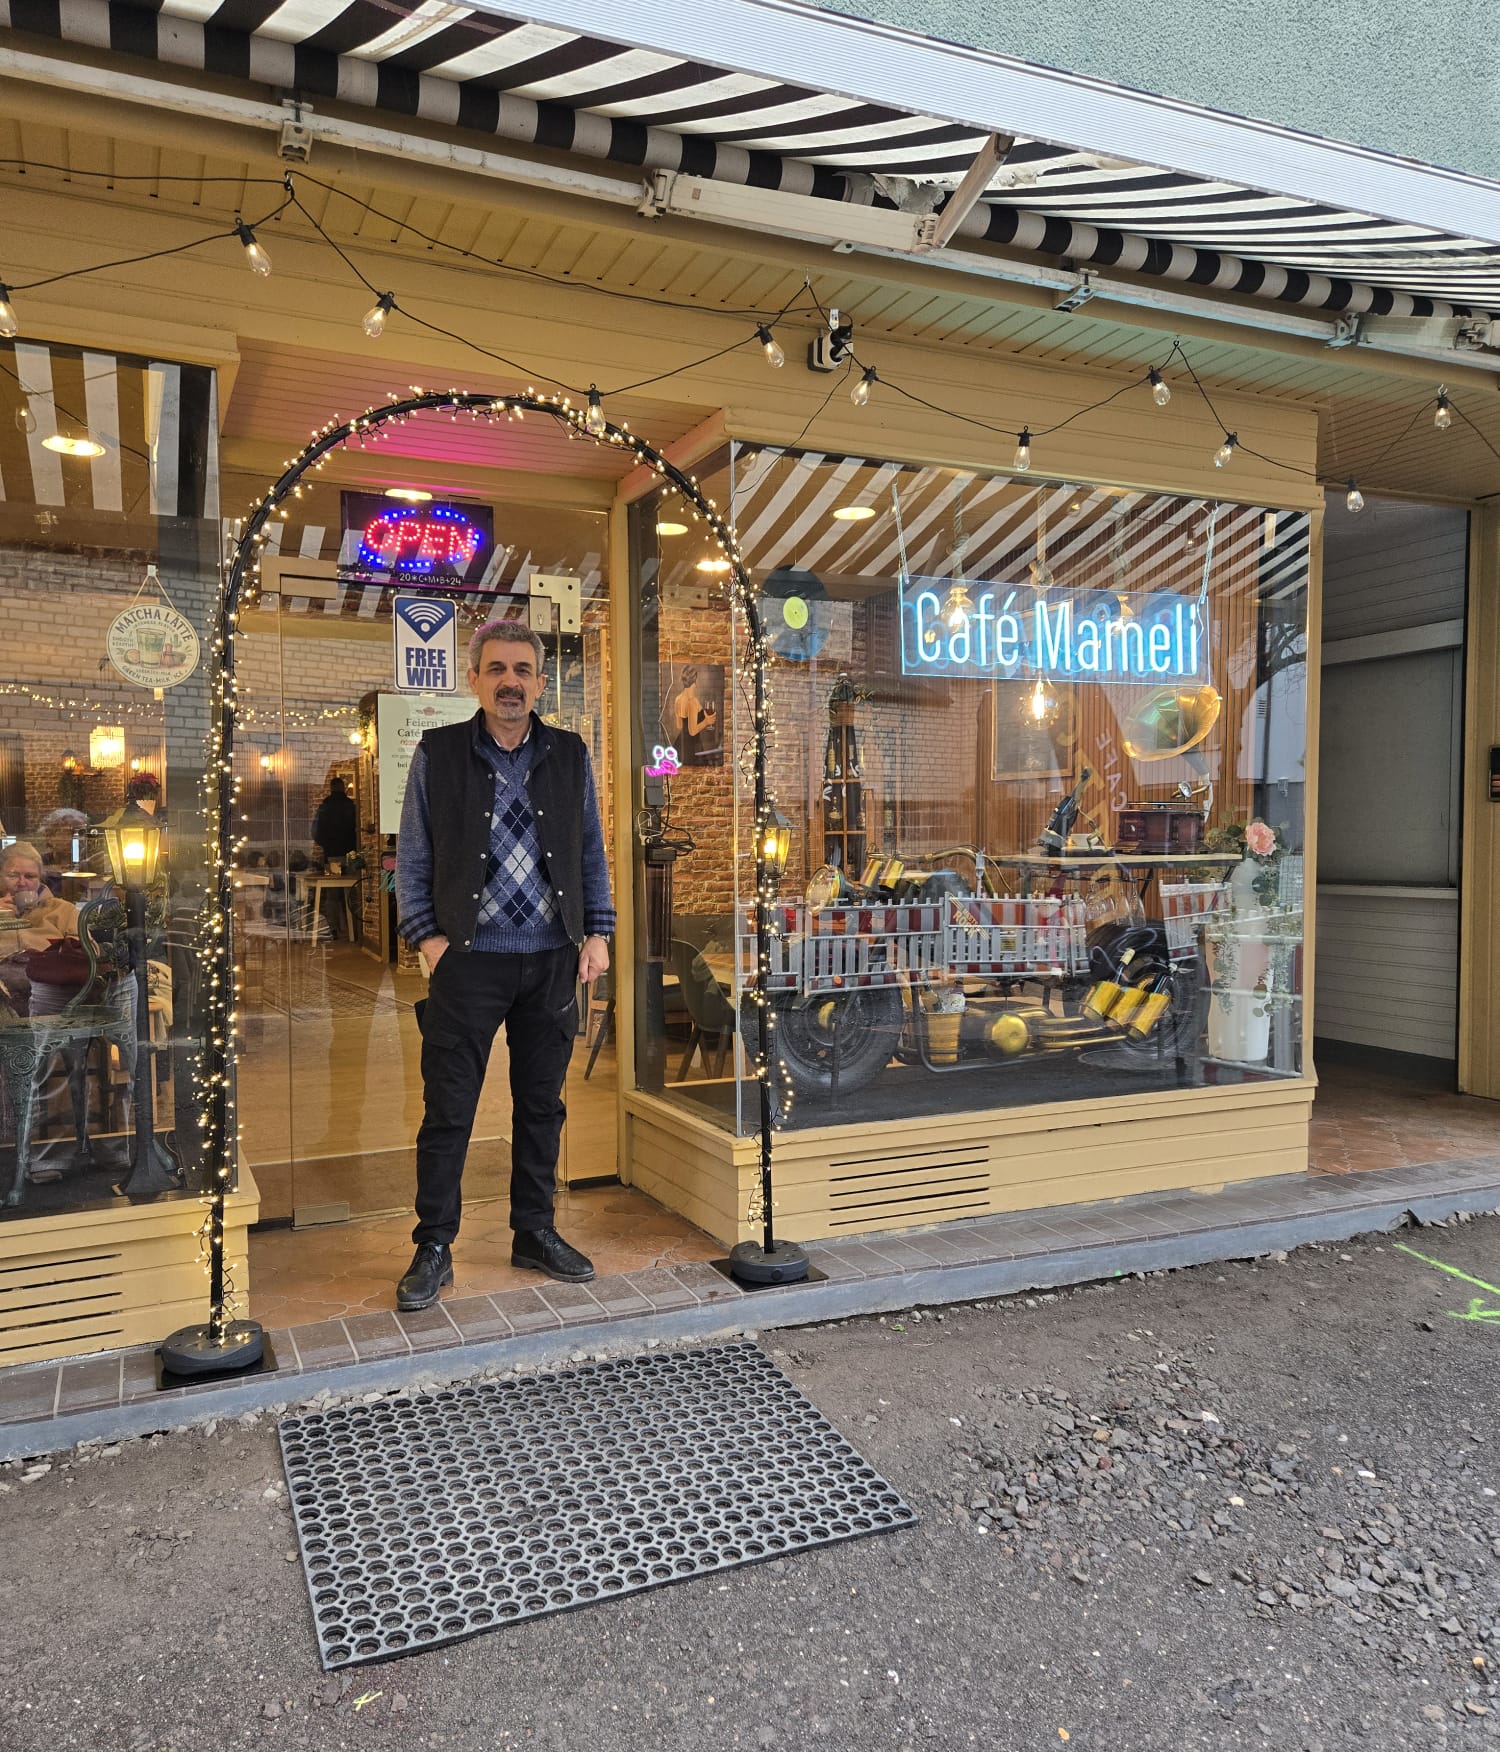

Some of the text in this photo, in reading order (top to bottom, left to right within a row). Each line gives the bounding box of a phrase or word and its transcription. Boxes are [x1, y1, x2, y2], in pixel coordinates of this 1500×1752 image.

[366, 518, 472, 558] OPEN
[114, 608, 194, 642] MATCHA LATTE
[916, 591, 1198, 675] Café Mameli
[405, 647, 447, 668] FREE
[406, 667, 447, 688] WIFI
[406, 717, 438, 727] Feiern
[397, 728, 421, 738] Café
